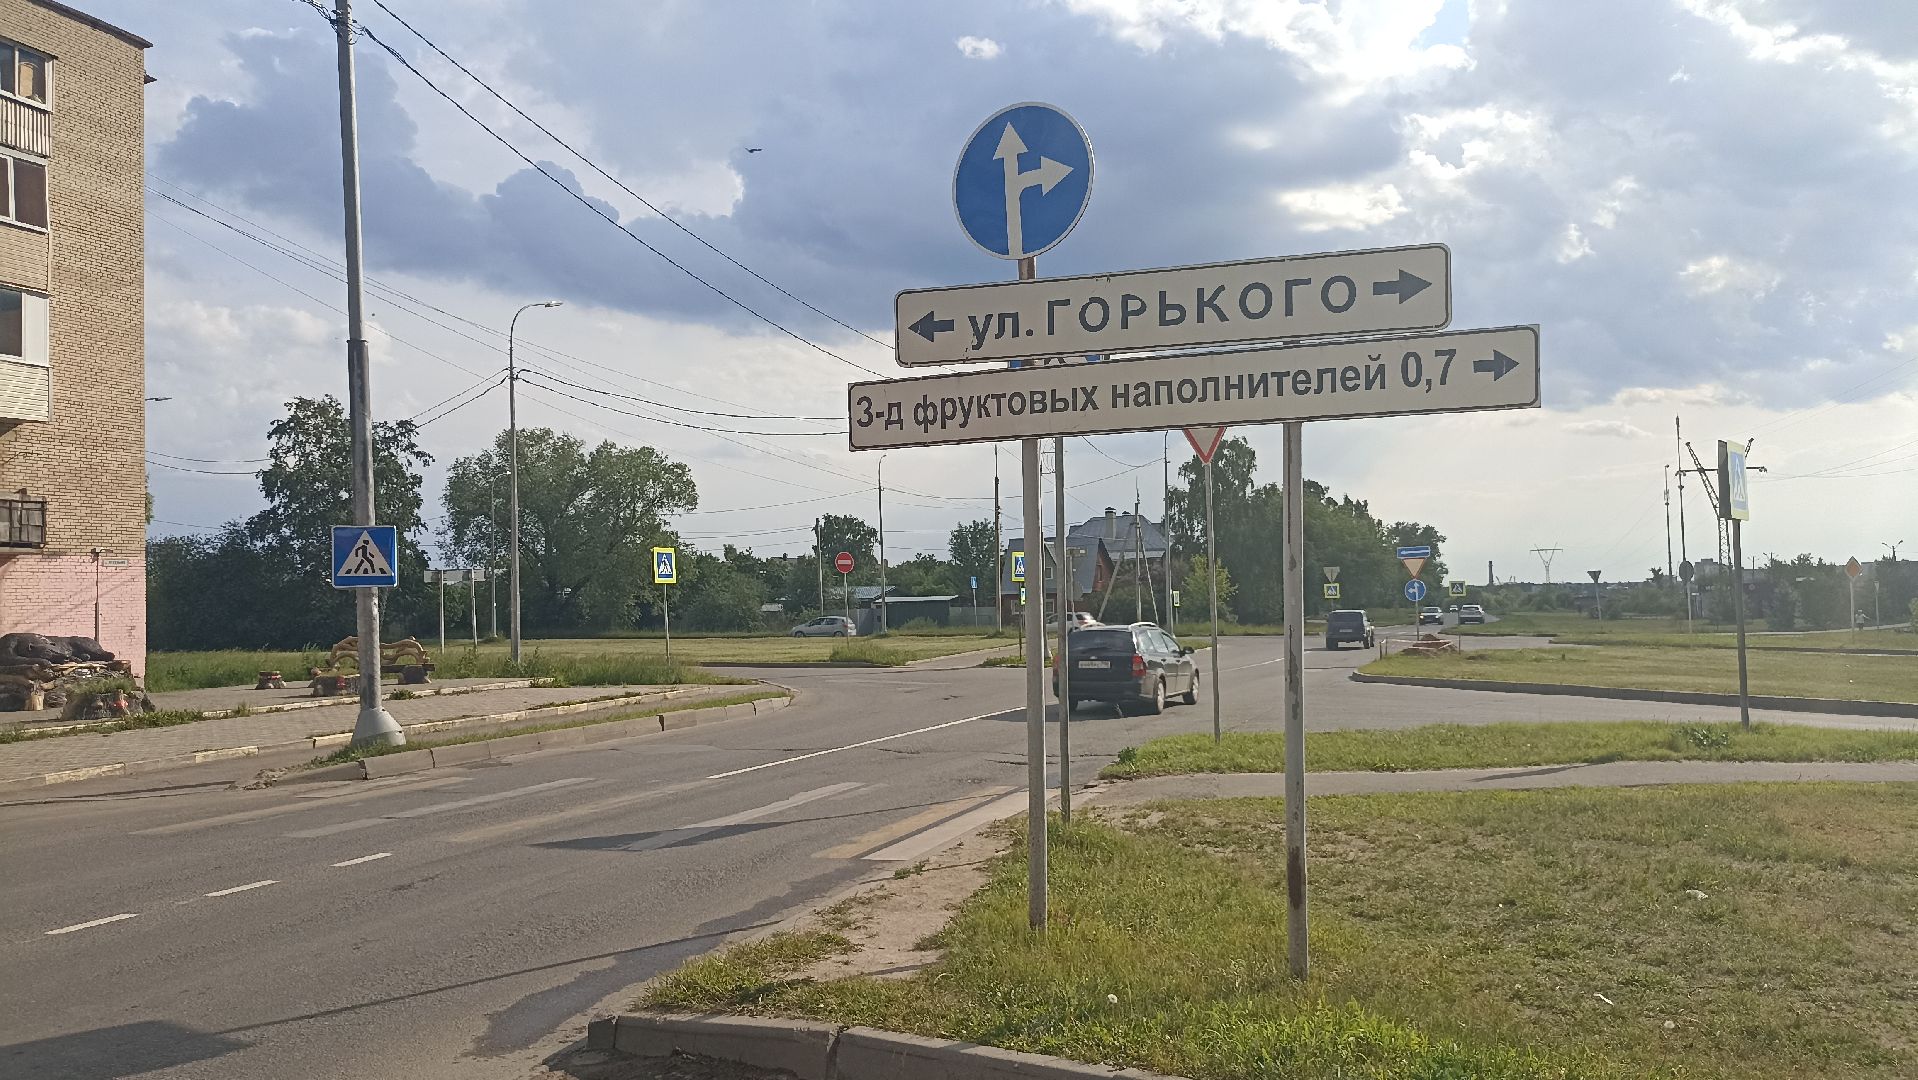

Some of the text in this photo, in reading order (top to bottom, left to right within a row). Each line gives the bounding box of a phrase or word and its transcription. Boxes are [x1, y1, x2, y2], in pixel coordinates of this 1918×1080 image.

[968, 275, 1357, 351] ул. ГОРЬКОГО
[913, 385, 1100, 433] фруктовых
[1111, 353, 1386, 409] наполнителей
[1400, 349, 1457, 394] 0,7
